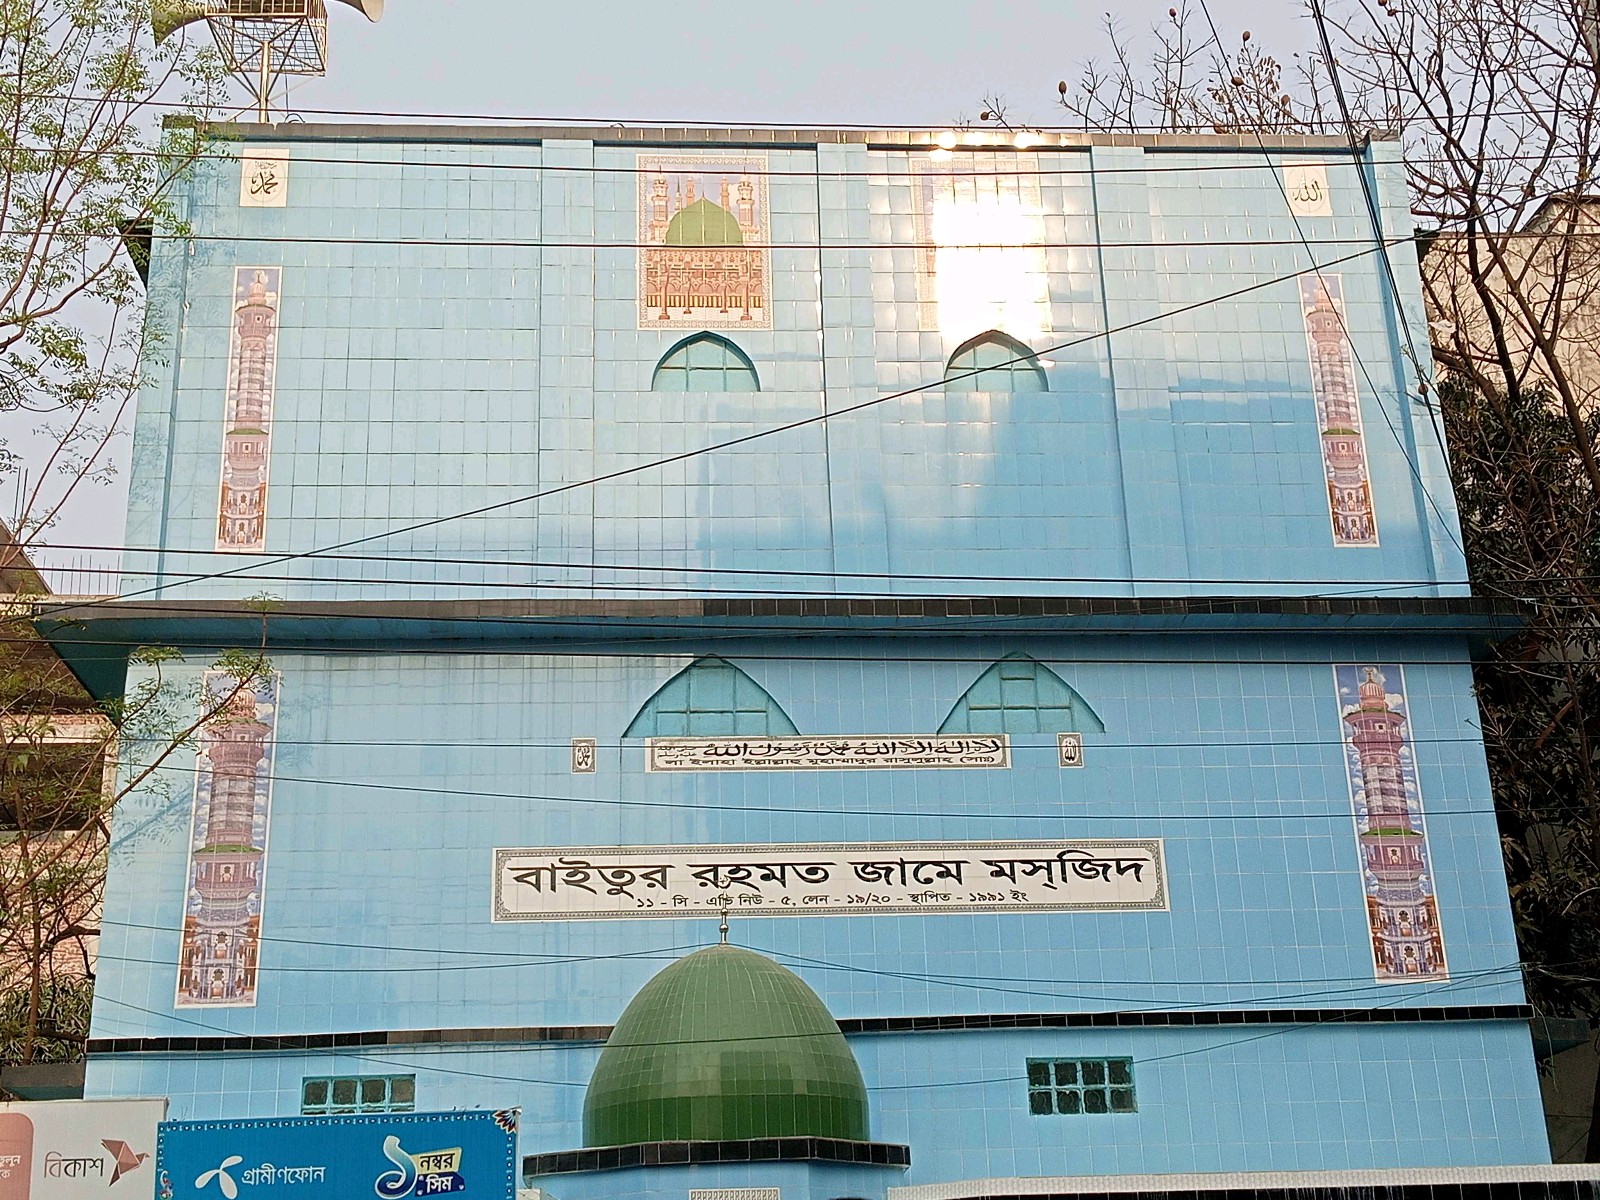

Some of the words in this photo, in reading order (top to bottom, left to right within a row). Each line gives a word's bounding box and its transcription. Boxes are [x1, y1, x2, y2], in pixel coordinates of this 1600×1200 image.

[507, 857, 676, 900] বাইতুর
[686, 861, 837, 893] রহমত
[847, 857, 971, 887] জামে
[636, 897, 654, 908] ১১
[672, 894, 688, 907] সি
[802, 894, 829, 906] লেন
[847, 892, 891, 906] ১৯/২০
[908, 890, 952, 905] স্থাপিত
[969, 892, 1005, 903] ১৯৯১
[1009, 889, 1029, 902] ইং
[44, 1151, 104, 1178] বিকাশ
[420, 1152, 455, 1171] নম্বর
[241, 1163, 326, 1186] গ্রামীণফোন
[426, 1174, 453, 1193] সিম
